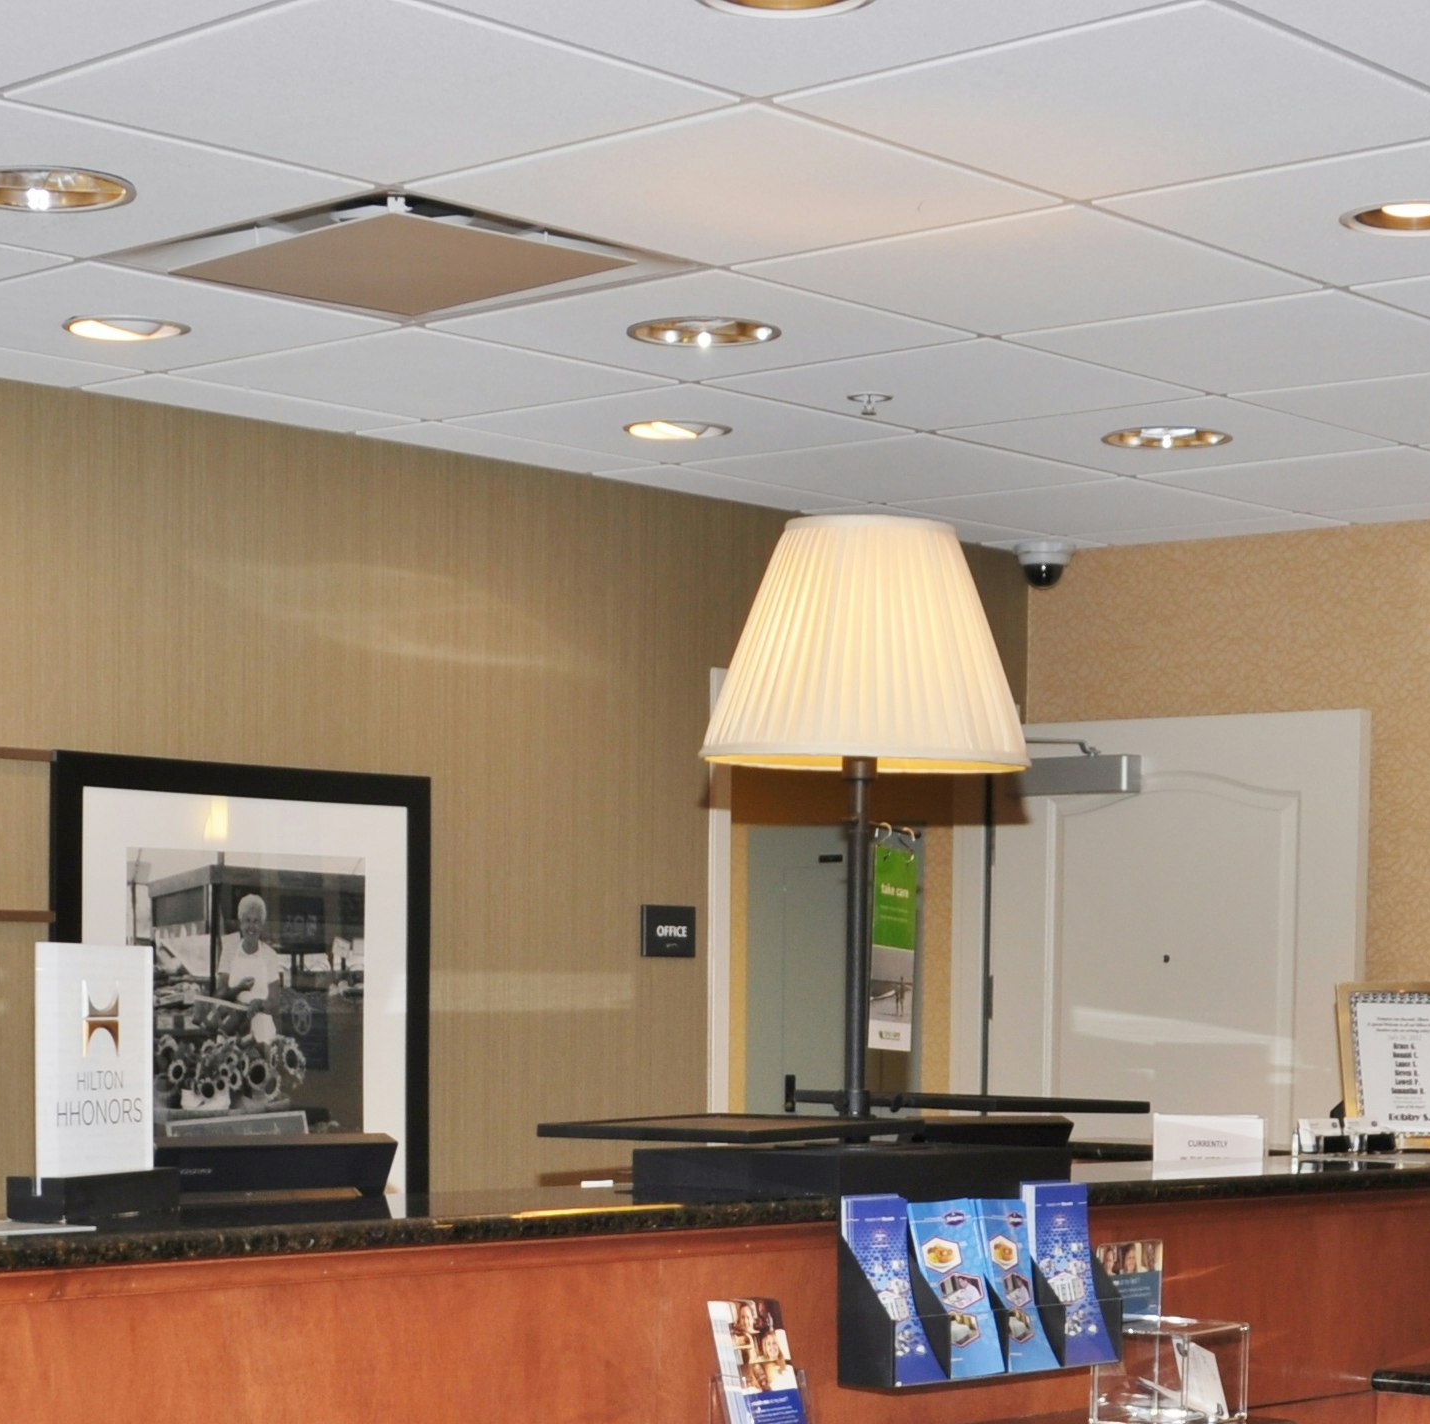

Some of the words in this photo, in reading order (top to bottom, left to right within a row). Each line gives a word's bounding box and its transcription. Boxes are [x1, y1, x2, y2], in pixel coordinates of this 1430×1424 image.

[656, 924, 688, 938] OFFICE
[76, 1069, 124, 1092] HILTON
[56, 1097, 143, 1128] HHONORS
[1187, 1139, 1228, 1148] CURRENTLY
